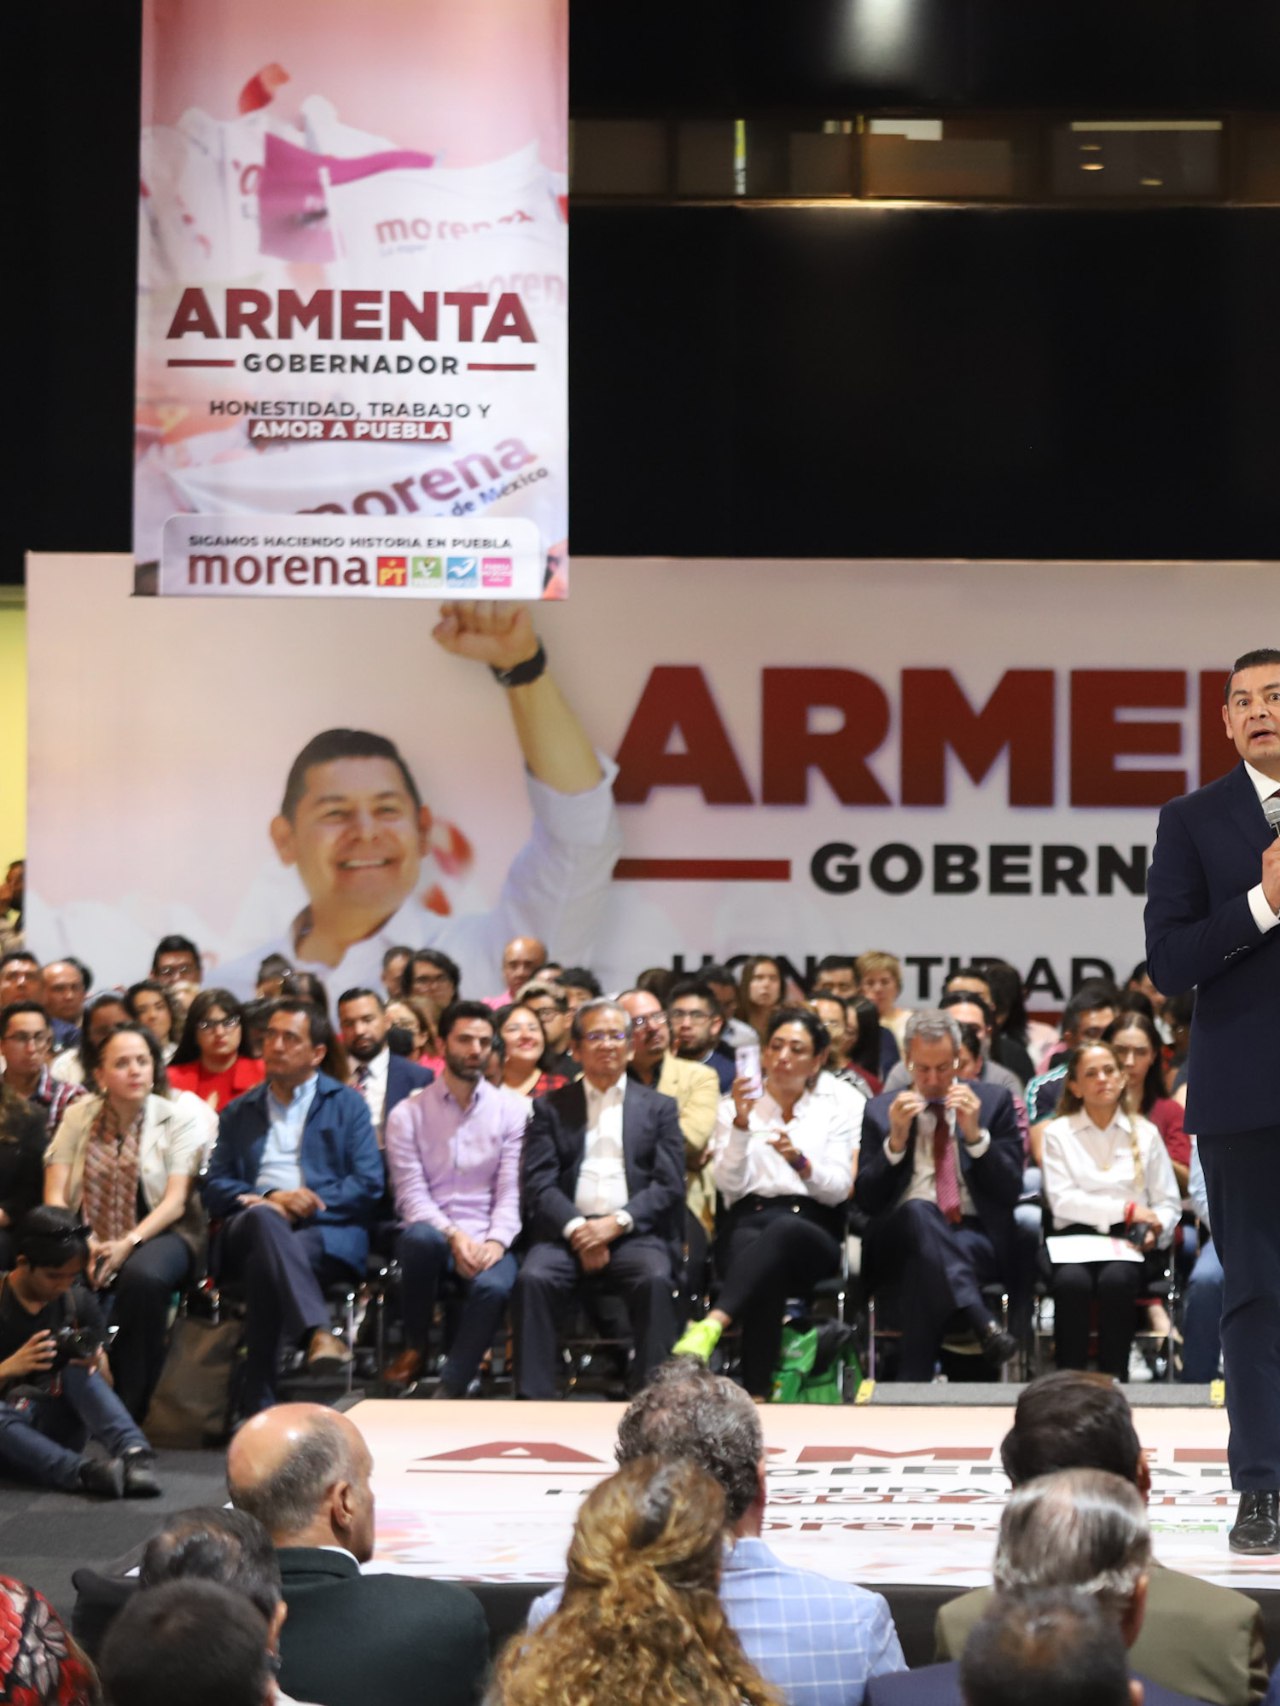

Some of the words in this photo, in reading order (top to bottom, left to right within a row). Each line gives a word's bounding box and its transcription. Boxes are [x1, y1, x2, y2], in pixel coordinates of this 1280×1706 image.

[166, 288, 537, 343] ARMENTA
[243, 353, 459, 375] GOBERNADOR
[209, 400, 361, 419] HONESTIDAD,
[370, 402, 470, 418] TRABAJO
[478, 403, 491, 418] Y
[252, 421, 325, 439] AMOR
[330, 422, 349, 439] A
[354, 422, 449, 440] PUEBLA
[296, 437, 538, 515] orena
[189, 535, 260, 547] SIGAMOS
[264, 536, 345, 548] HACIENDO
[350, 536, 422, 548] HISTORIA
[427, 537, 446, 548] EN
[452, 537, 512, 549] PUEBLA
[188, 555, 370, 586] morena
[379, 567, 407, 586] PT
[810, 841, 1148, 897] GOBERN
